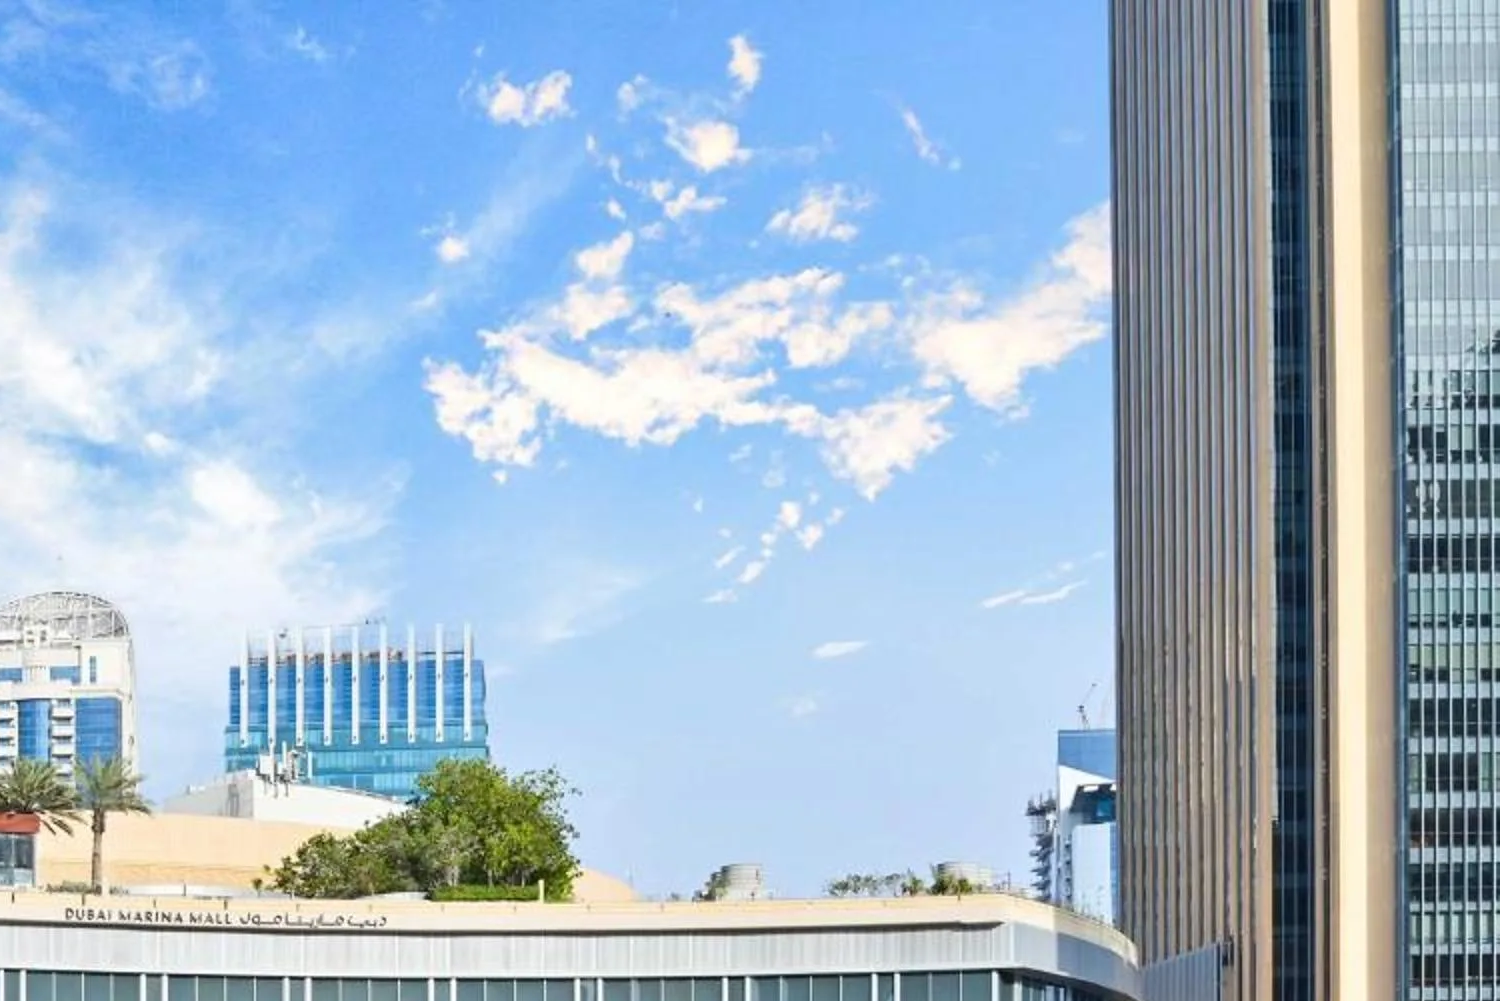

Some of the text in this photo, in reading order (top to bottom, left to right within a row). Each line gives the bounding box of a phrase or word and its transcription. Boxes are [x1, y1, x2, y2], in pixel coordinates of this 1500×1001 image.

[64, 907, 233, 925] DUBAI MARINA MALL
